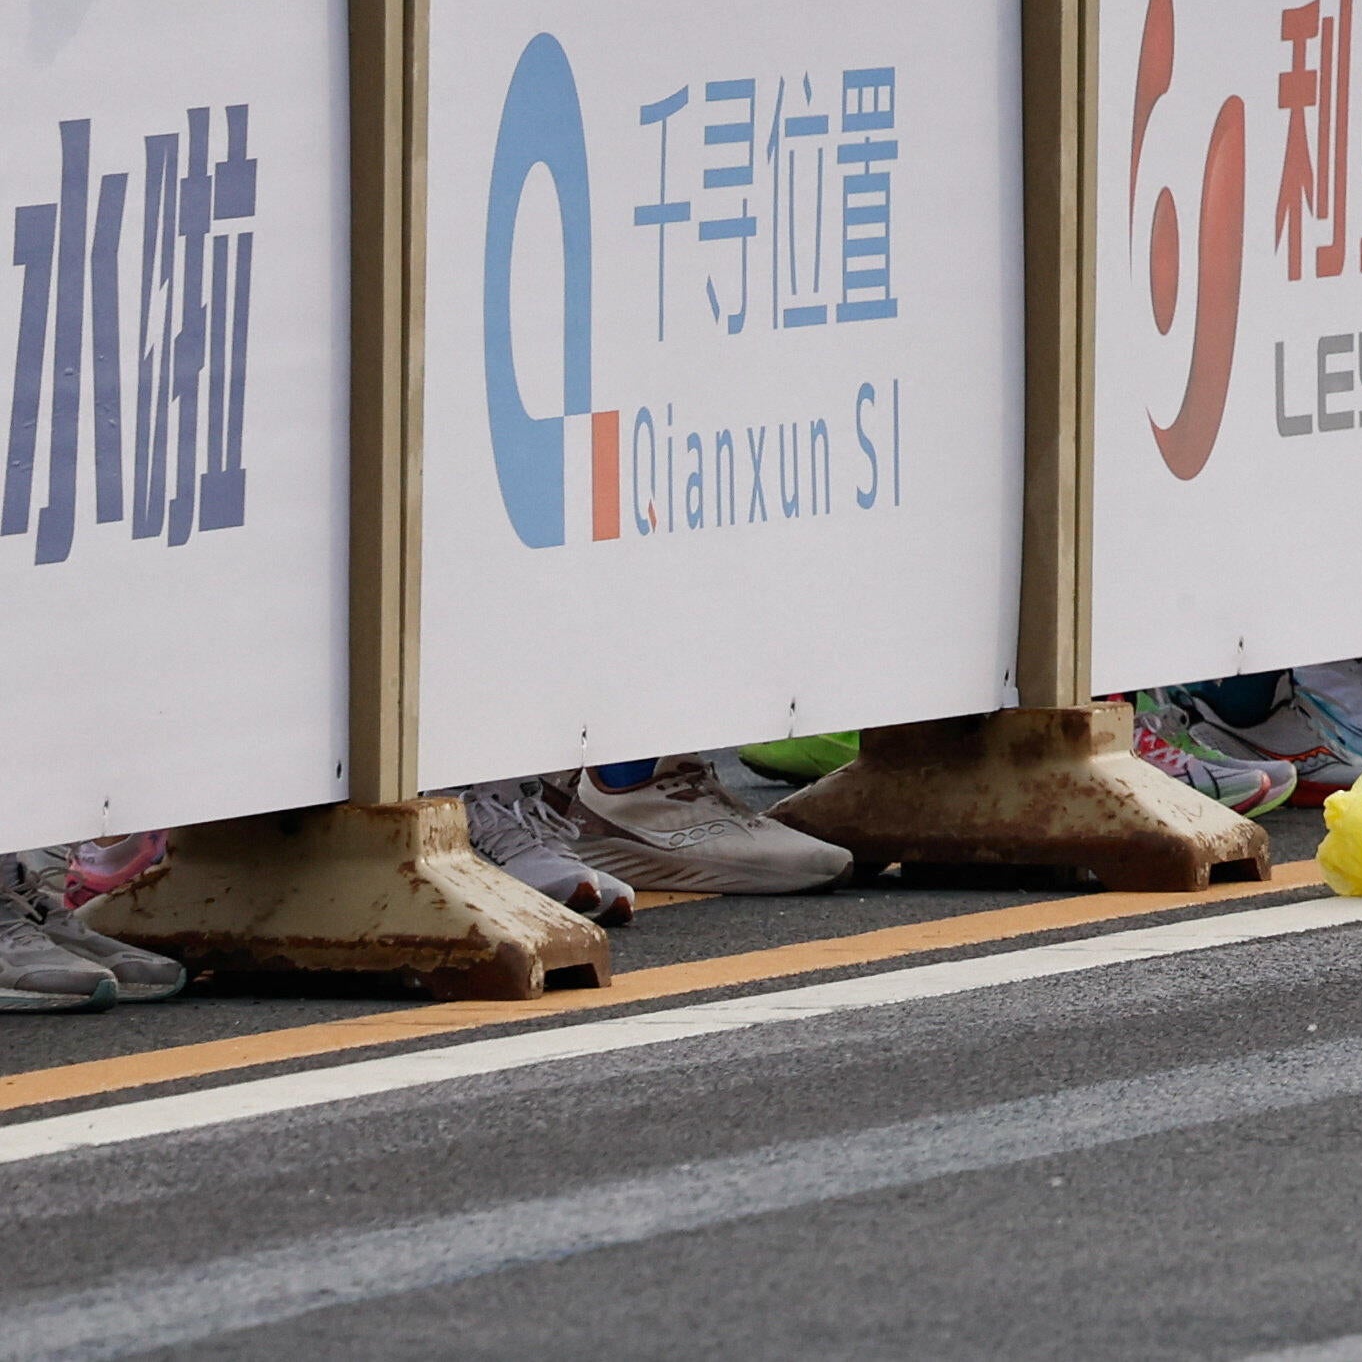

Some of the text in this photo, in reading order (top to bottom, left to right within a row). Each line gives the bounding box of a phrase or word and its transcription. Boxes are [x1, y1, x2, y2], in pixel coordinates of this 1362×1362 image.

[1, 104, 257, 566] 水啦
[634, 67, 899, 342] 千寻位置
[633, 379, 901, 535] Qianxun SI
